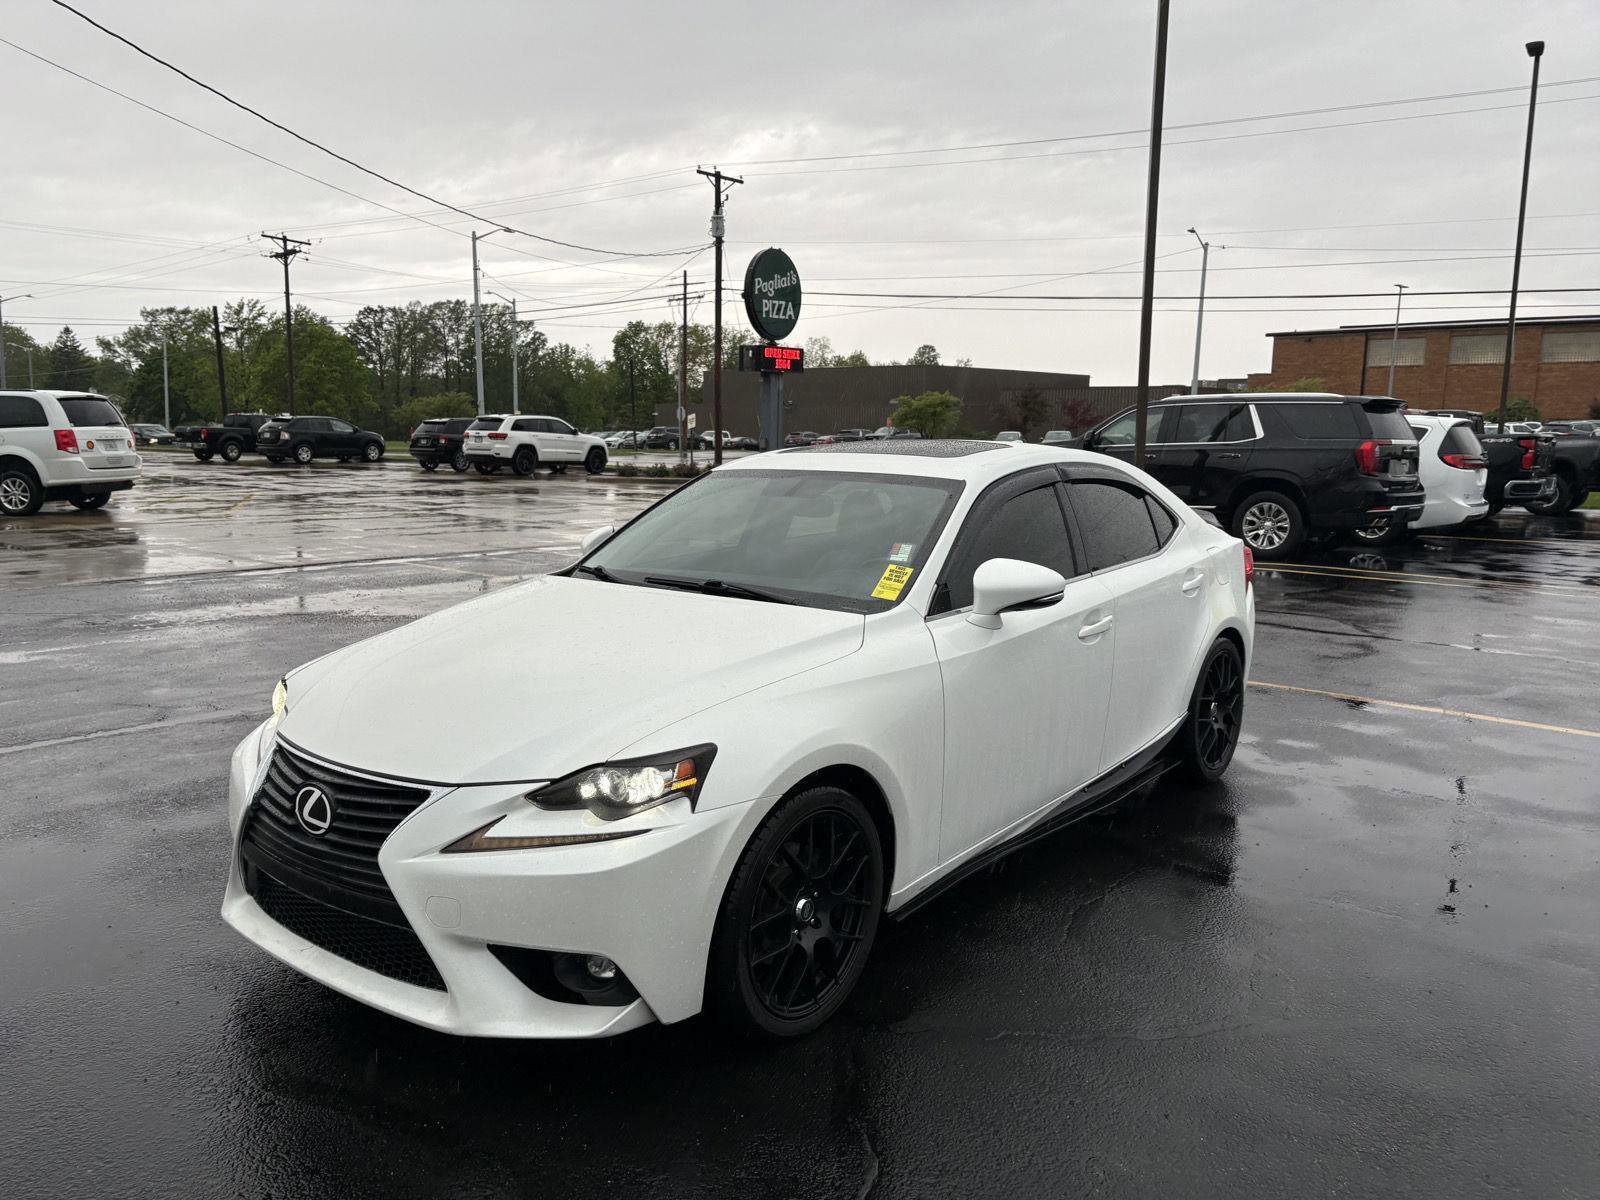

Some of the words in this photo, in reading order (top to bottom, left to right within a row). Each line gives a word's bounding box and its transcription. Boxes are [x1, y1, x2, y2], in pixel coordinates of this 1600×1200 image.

[754, 271, 797, 297] Pagliai's
[762, 299, 795, 320] PIZZA
[764, 347, 782, 358] OPEN
